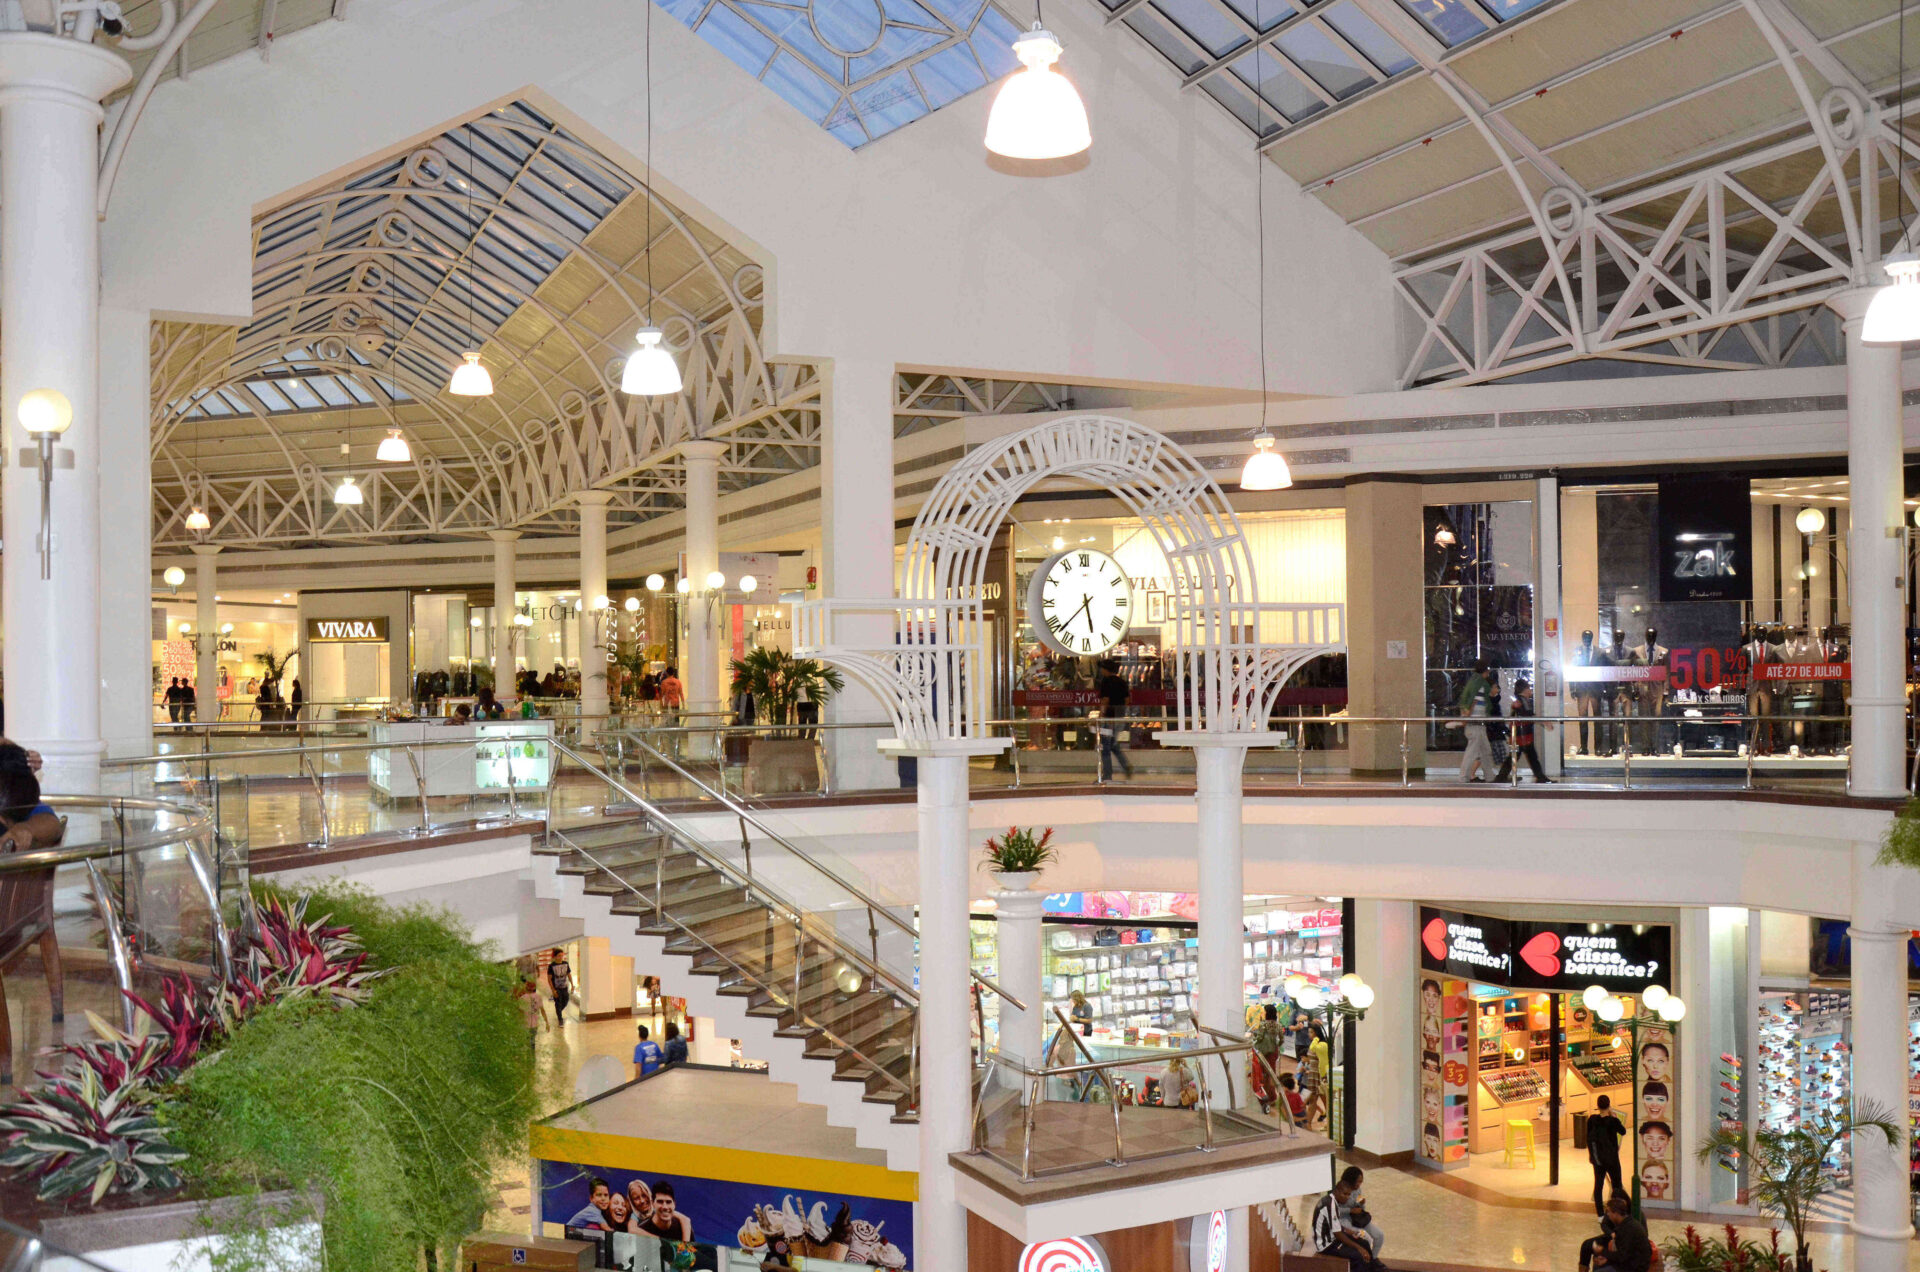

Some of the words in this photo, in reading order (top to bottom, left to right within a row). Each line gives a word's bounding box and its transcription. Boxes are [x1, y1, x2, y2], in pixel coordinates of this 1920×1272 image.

[1674, 540, 1737, 577] zak
[1128, 576, 1158, 590] VIA
[317, 621, 377, 638] VIVARA
[1766, 664, 1784, 678] ATÉ
[1785, 667, 1797, 677] 27
[1799, 667, 1812, 677] DE
[1813, 665, 1842, 677] JULHO
[1448, 923, 1482, 939] quem
[1563, 935, 1617, 951] quem
[1448, 945, 1509, 970] berenice?
[1572, 947, 1628, 965] disse,
[1564, 959, 1659, 978] berenice?
